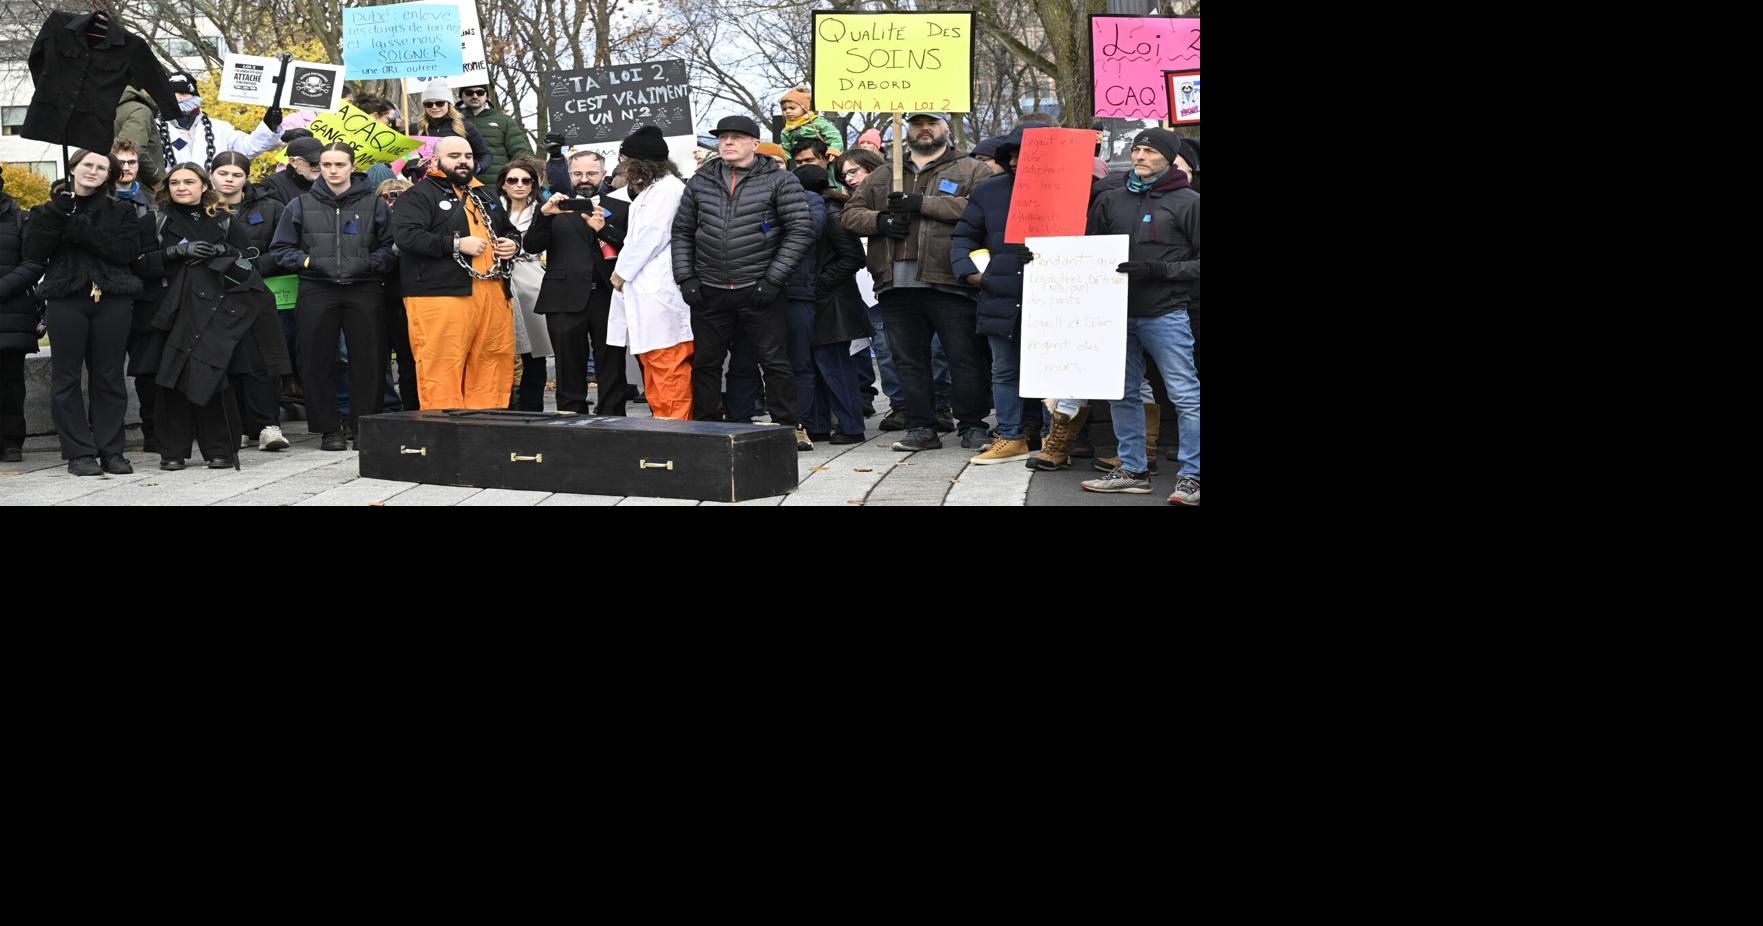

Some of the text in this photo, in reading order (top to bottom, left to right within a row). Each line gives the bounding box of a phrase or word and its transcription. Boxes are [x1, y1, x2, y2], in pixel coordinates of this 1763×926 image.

[409, 22, 422, 31] de
[412, 35, 442, 45] nous
[1102, 23, 1200, 56] Loi 2
[378, 46, 447, 61] SOIGNER
[846, 48, 942, 73] SOINS
[234, 72, 262, 83] ATTACHÉ
[569, 76, 600, 92] TA
[609, 68, 643, 85] LOI
[839, 77, 911, 91] D'ABORD
[565, 84, 689, 114] C'EST VRAIMENT
[831, 97, 951, 111] NON À LA LOI 2
[589, 110, 613, 125] UN
[310, 119, 347, 143] GANG
[343, 114, 396, 152] CAQ
